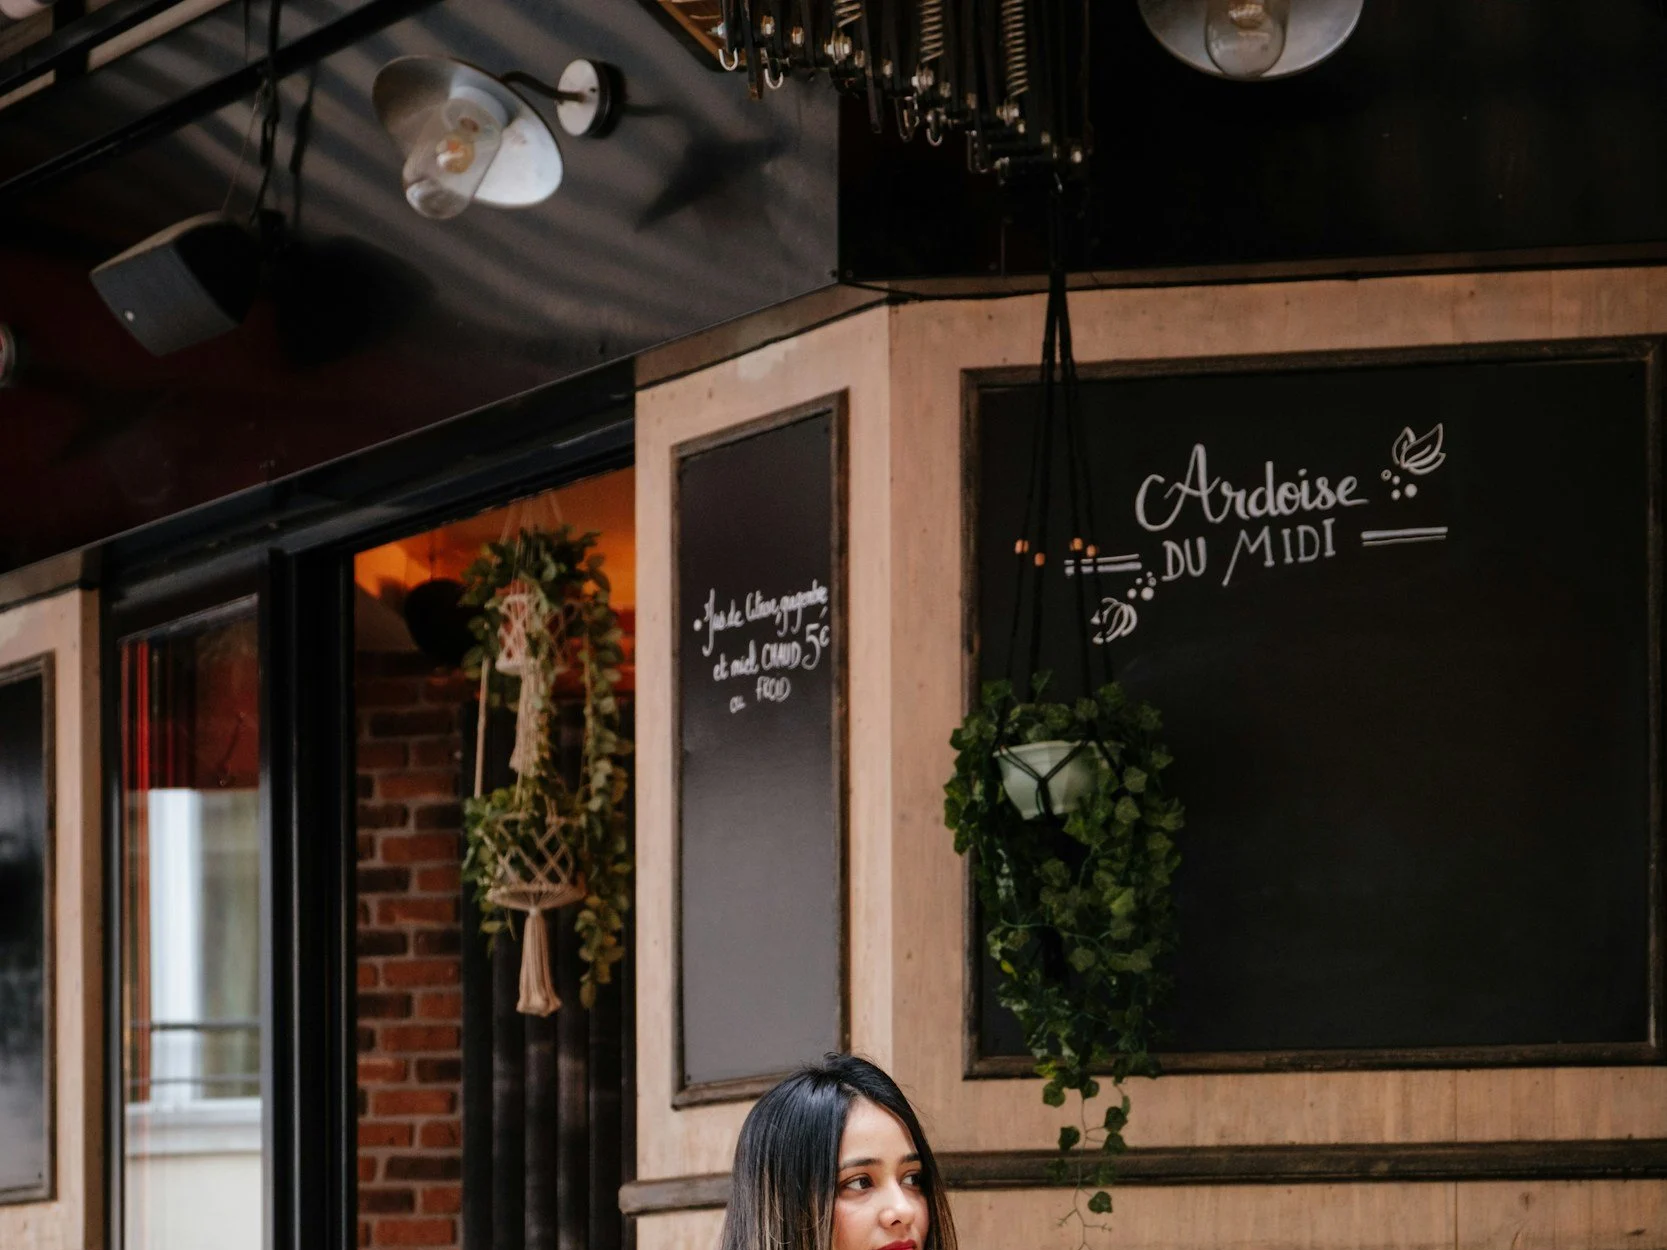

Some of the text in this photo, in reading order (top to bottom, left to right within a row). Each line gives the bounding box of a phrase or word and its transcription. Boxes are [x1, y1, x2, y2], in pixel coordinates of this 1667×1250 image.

[1135, 443, 1370, 532] Ardoise
[1162, 517, 1336, 587] DU MIDI
[713, 653, 730, 681] et
